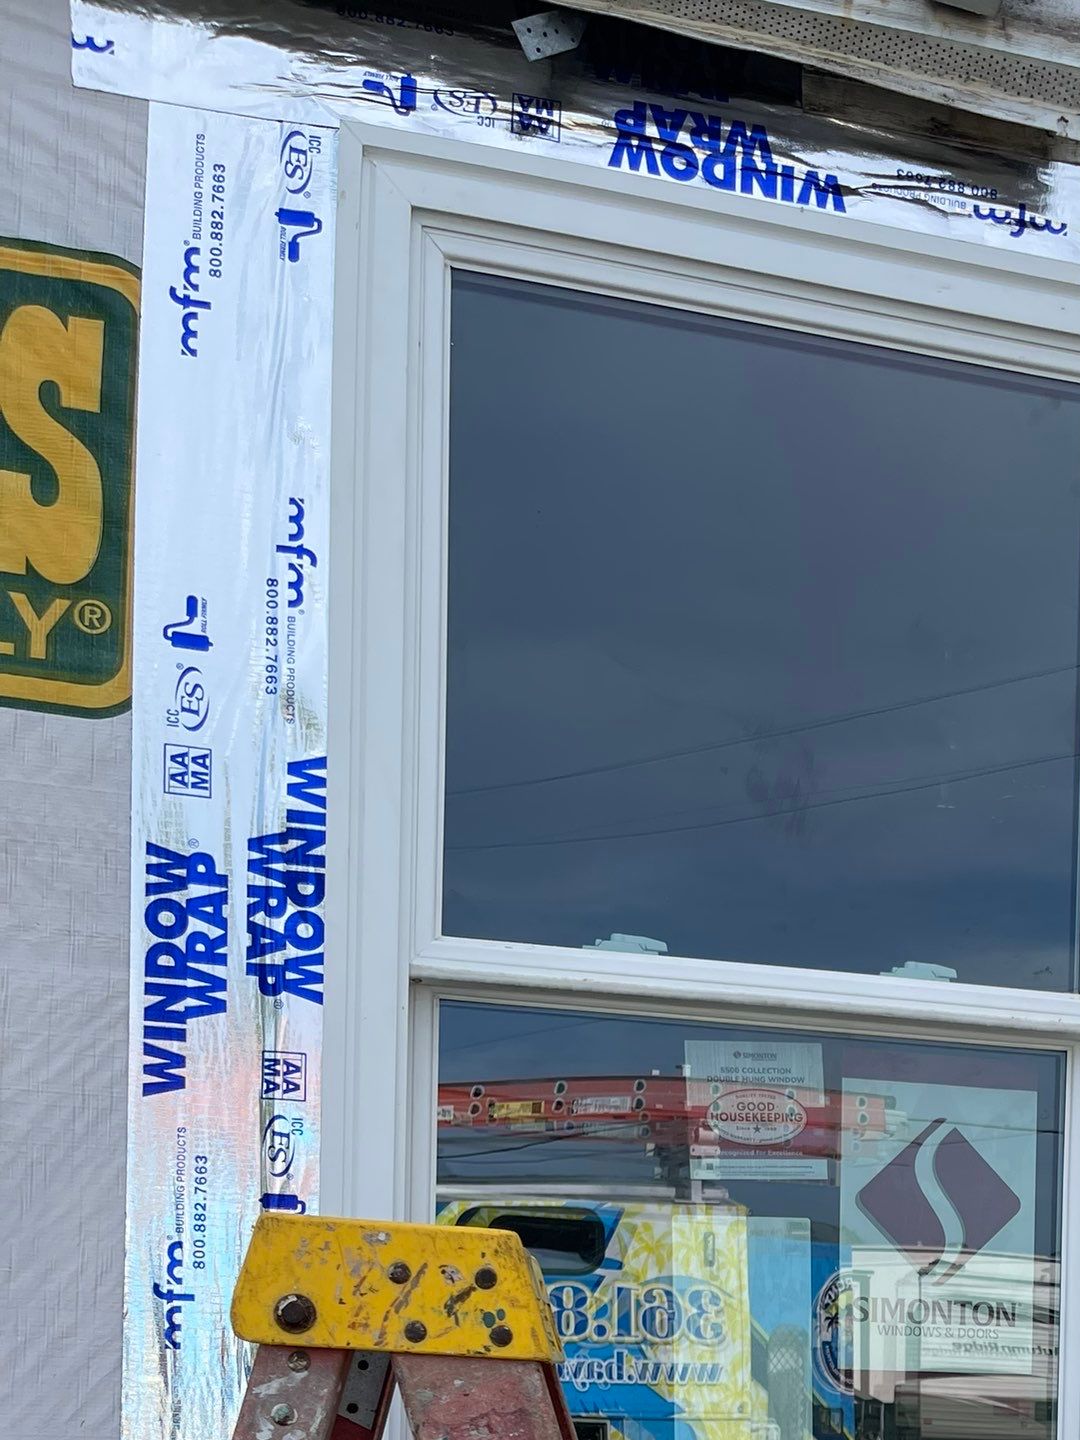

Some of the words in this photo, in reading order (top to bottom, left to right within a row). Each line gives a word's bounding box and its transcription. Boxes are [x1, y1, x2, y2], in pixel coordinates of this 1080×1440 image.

[308, 135, 321, 154] ICC
[477, 115, 495, 128] ICC
[614, 101, 773, 169] WRAP
[195, 133, 206, 184] PRODUCTS
[284, 145, 307, 181] ES
[607, 136, 847, 213] WINDOW
[192, 186, 204, 240] BUILDING
[209, 163, 226, 278] 800.882.7663
[973, 203, 1068, 238] mfm
[169, 246, 212, 357] mfm
[275, 497, 318, 608] mfm
[265, 577, 279, 696] 800.882.7663
[286, 616, 297, 664] BUILDING
[166, 708, 180, 727] ICC
[180, 681, 205, 717] ES
[285, 666, 296, 725] PRODUCTS
[169, 751, 189, 788] AA
[190, 753, 209, 791] MA
[284, 756, 328, 1006] WINDOW
[186, 851, 229, 1020] WRAP
[246, 830, 288, 997] WRAP
[143, 841, 190, 1097] WINDOW
[263, 1058, 281, 1095] MA
[281, 1058, 301, 1095] AA
[707, 1075, 740, 1083] DOUBLE
[741, 1067, 792, 1075] COLLECTION
[291, 1117, 304, 1136] ICC
[710, 1112, 804, 1123] HOUSEKEEPING
[736, 1102, 775, 1112] GOOD
[177, 1127, 187, 1182] PRODUCTS
[176, 1183, 186, 1234] BUILDING
[193, 1155, 208, 1270] 800.882.7663
[153, 1240, 196, 1351] mfm
[852, 1296, 1017, 1328] SIMONTON
[877, 1325, 942, 1338] WINDOWS
[944, 1326, 954, 1338] &
[957, 1327, 999, 1340] DOORS
